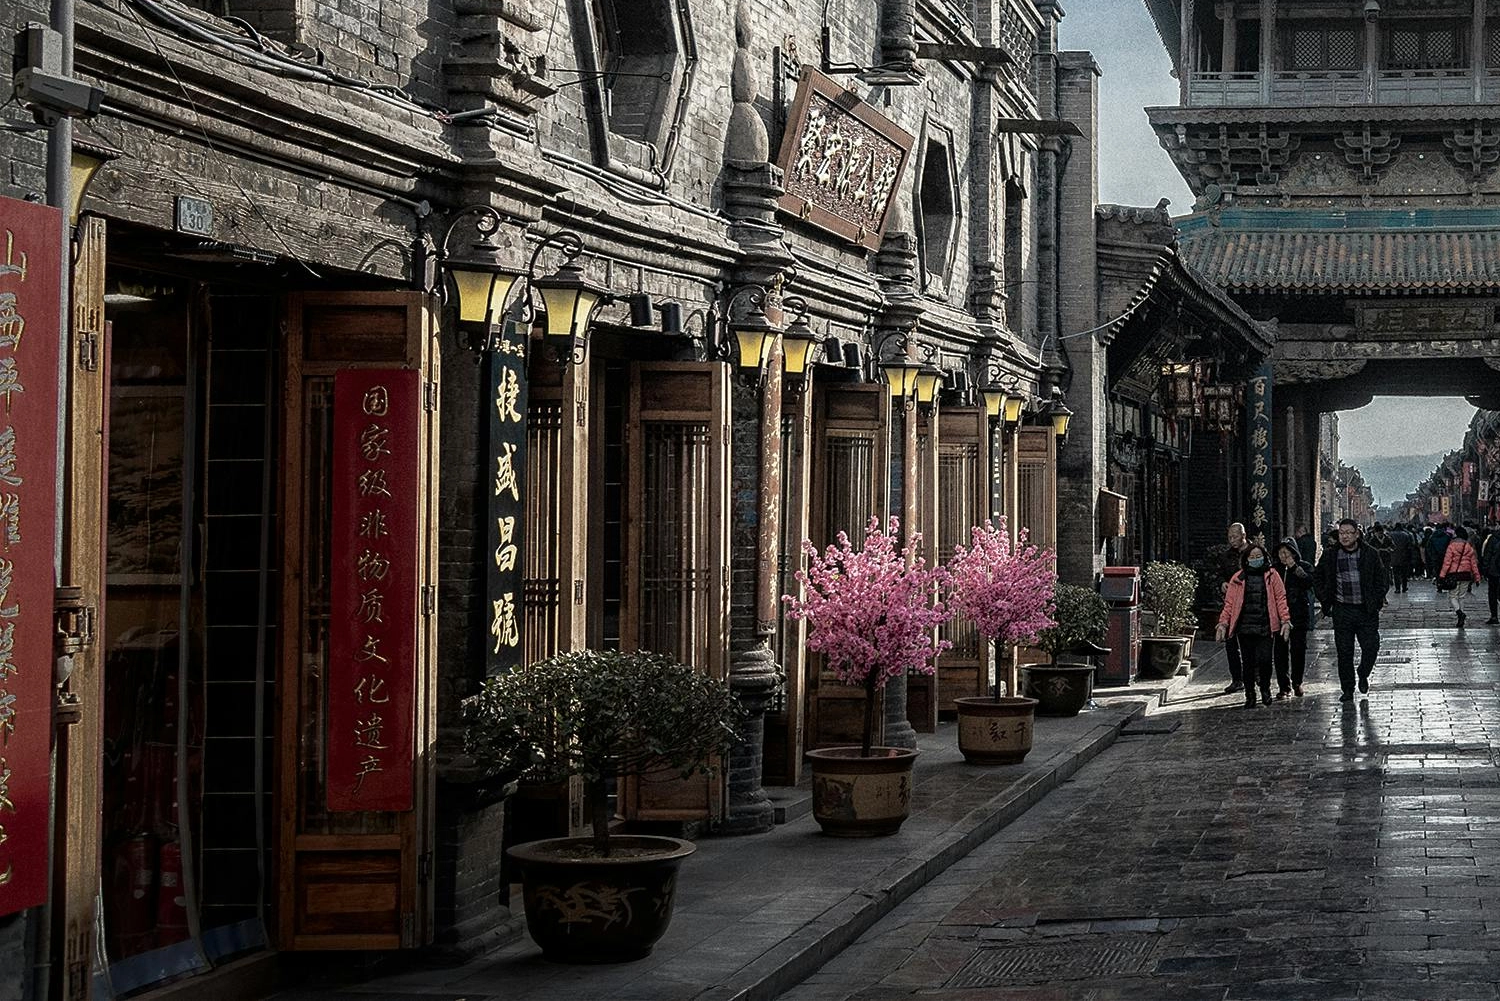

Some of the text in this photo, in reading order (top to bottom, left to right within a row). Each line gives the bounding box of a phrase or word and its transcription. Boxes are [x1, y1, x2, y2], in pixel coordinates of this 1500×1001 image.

[188, 213, 204, 230] 30
[352, 384, 393, 796] 国家级非物质文化遗产
